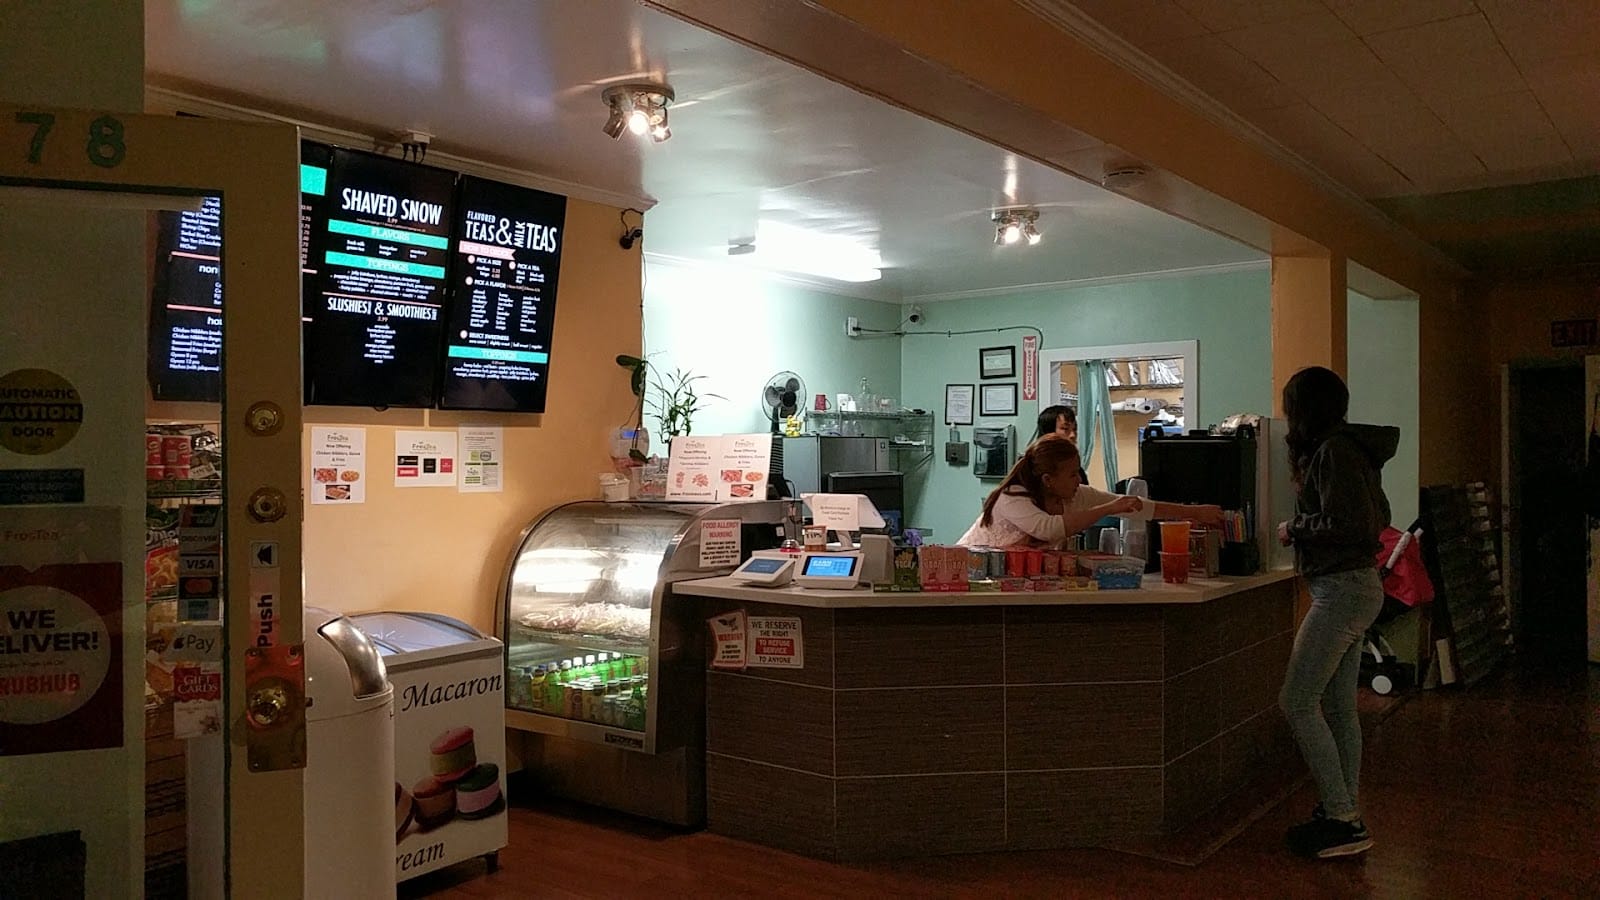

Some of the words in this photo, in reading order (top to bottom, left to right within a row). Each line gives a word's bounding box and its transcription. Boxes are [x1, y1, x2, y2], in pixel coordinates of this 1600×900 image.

[342, 187, 397, 217] SHAVED
[400, 198, 443, 225] SNOW
[465, 220, 495, 242] TEAS
[496, 218, 512, 246] &
[513, 221, 526, 248] MILK
[526, 222, 558, 253] TEAS
[198, 265, 218, 274] non
[328, 297, 368, 314] SLUSHIES
[374, 302, 384, 316] &
[386, 303, 432, 320] SMOOTHIES
[12, 426, 55, 437] DOOR
[186, 560, 214, 569] VISA
[7, 610, 55, 630] WE
[257, 594, 273, 648] Push
[752, 620, 764, 628] WE
[765, 621, 797, 630] RESERVE
[187, 634, 215, 653] Pay
[762, 646, 788, 654] SERVICE
[184, 675, 212, 686] GIFT
[178, 684, 218, 694] CARDS
[402, 674, 502, 712] Macaron
